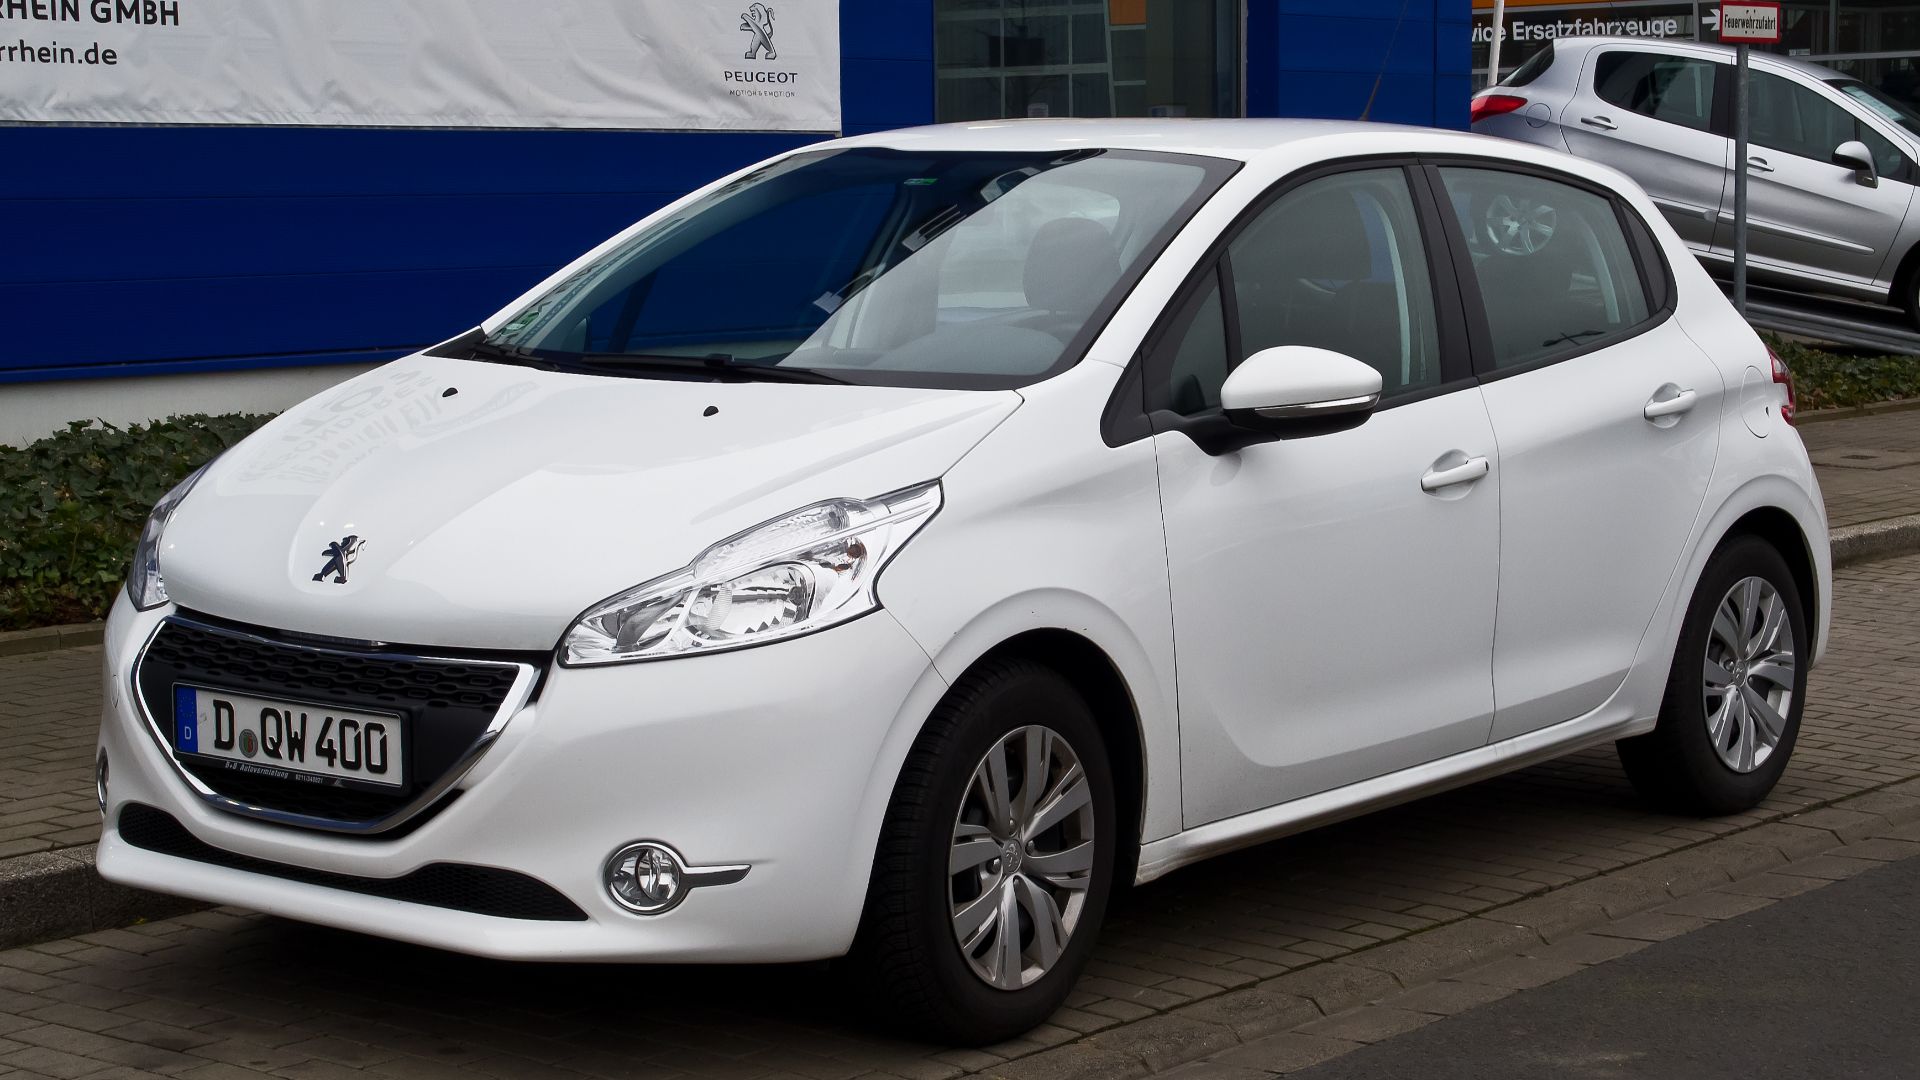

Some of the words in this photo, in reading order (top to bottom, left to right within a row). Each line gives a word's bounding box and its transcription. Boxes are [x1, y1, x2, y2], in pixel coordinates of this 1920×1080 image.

[91, 0, 179, 26] GMBH
[1512, 17, 1677, 41] Ersatzfahrzeuge
[1724, 14, 1776, 30] Feuerwehrzufahrt
[724, 71, 798, 84] PEUGEOT
[729, 89, 757, 97] MOTION
[764, 90, 795, 98] EMOTION
[184, 726, 192, 740] D
[212, 699, 235, 750] D
[260, 707, 308, 763] QW
[315, 716, 388, 774] 400
[240, 763, 289, 779] Autovermietung
